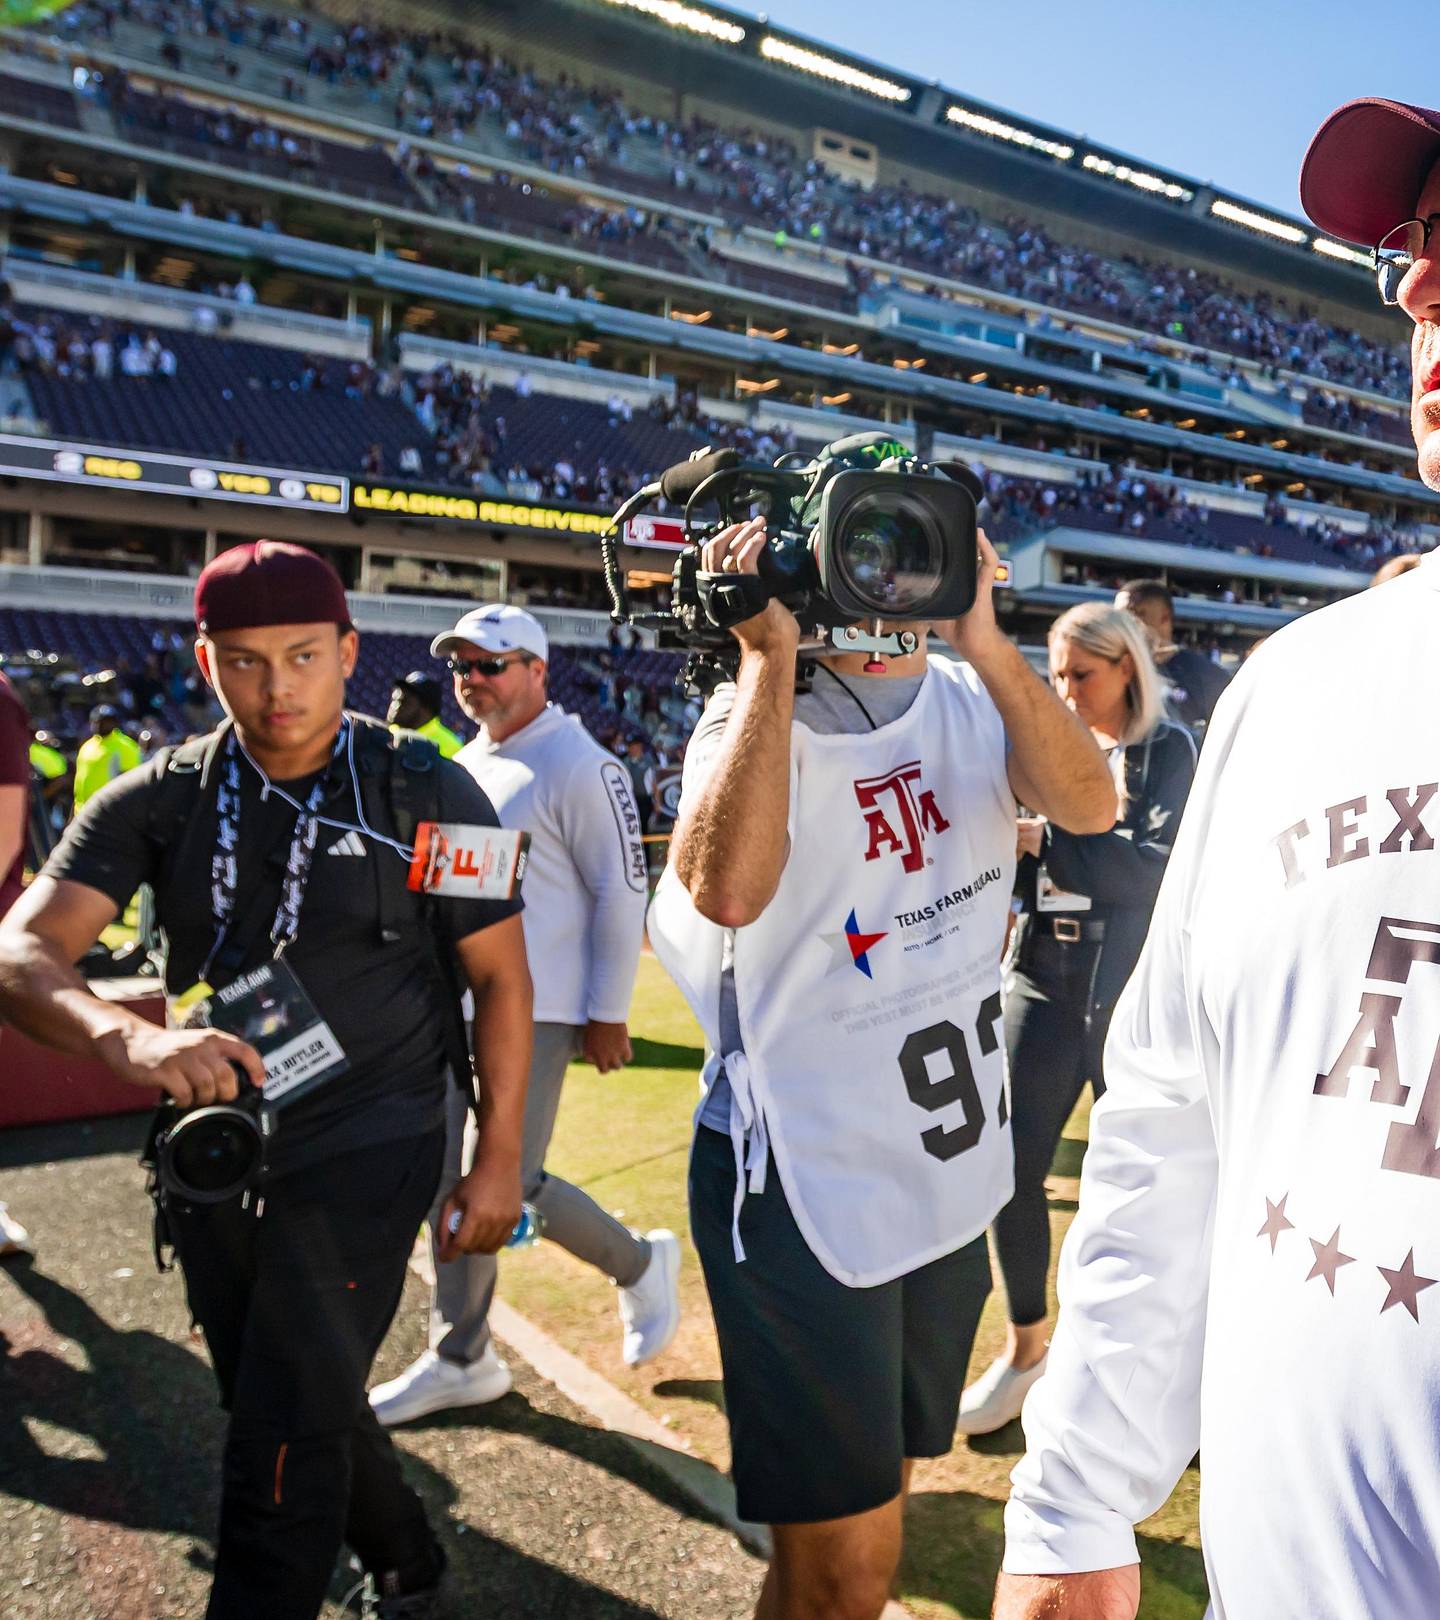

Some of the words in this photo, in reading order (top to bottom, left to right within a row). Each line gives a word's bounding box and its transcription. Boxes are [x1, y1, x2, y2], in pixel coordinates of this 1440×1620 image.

[354, 486, 478, 520] LEADING
[480, 502, 618, 536] RECEIVERS
[611, 775, 639, 836] TEXAS
[630, 842, 646, 878] A&M
[453, 848, 479, 876] F
[894, 906, 936, 928] TEXAS
[935, 885, 974, 912] FARM
[903, 943, 920, 952] AUTO
[217, 974, 251, 1005] TEXAS
